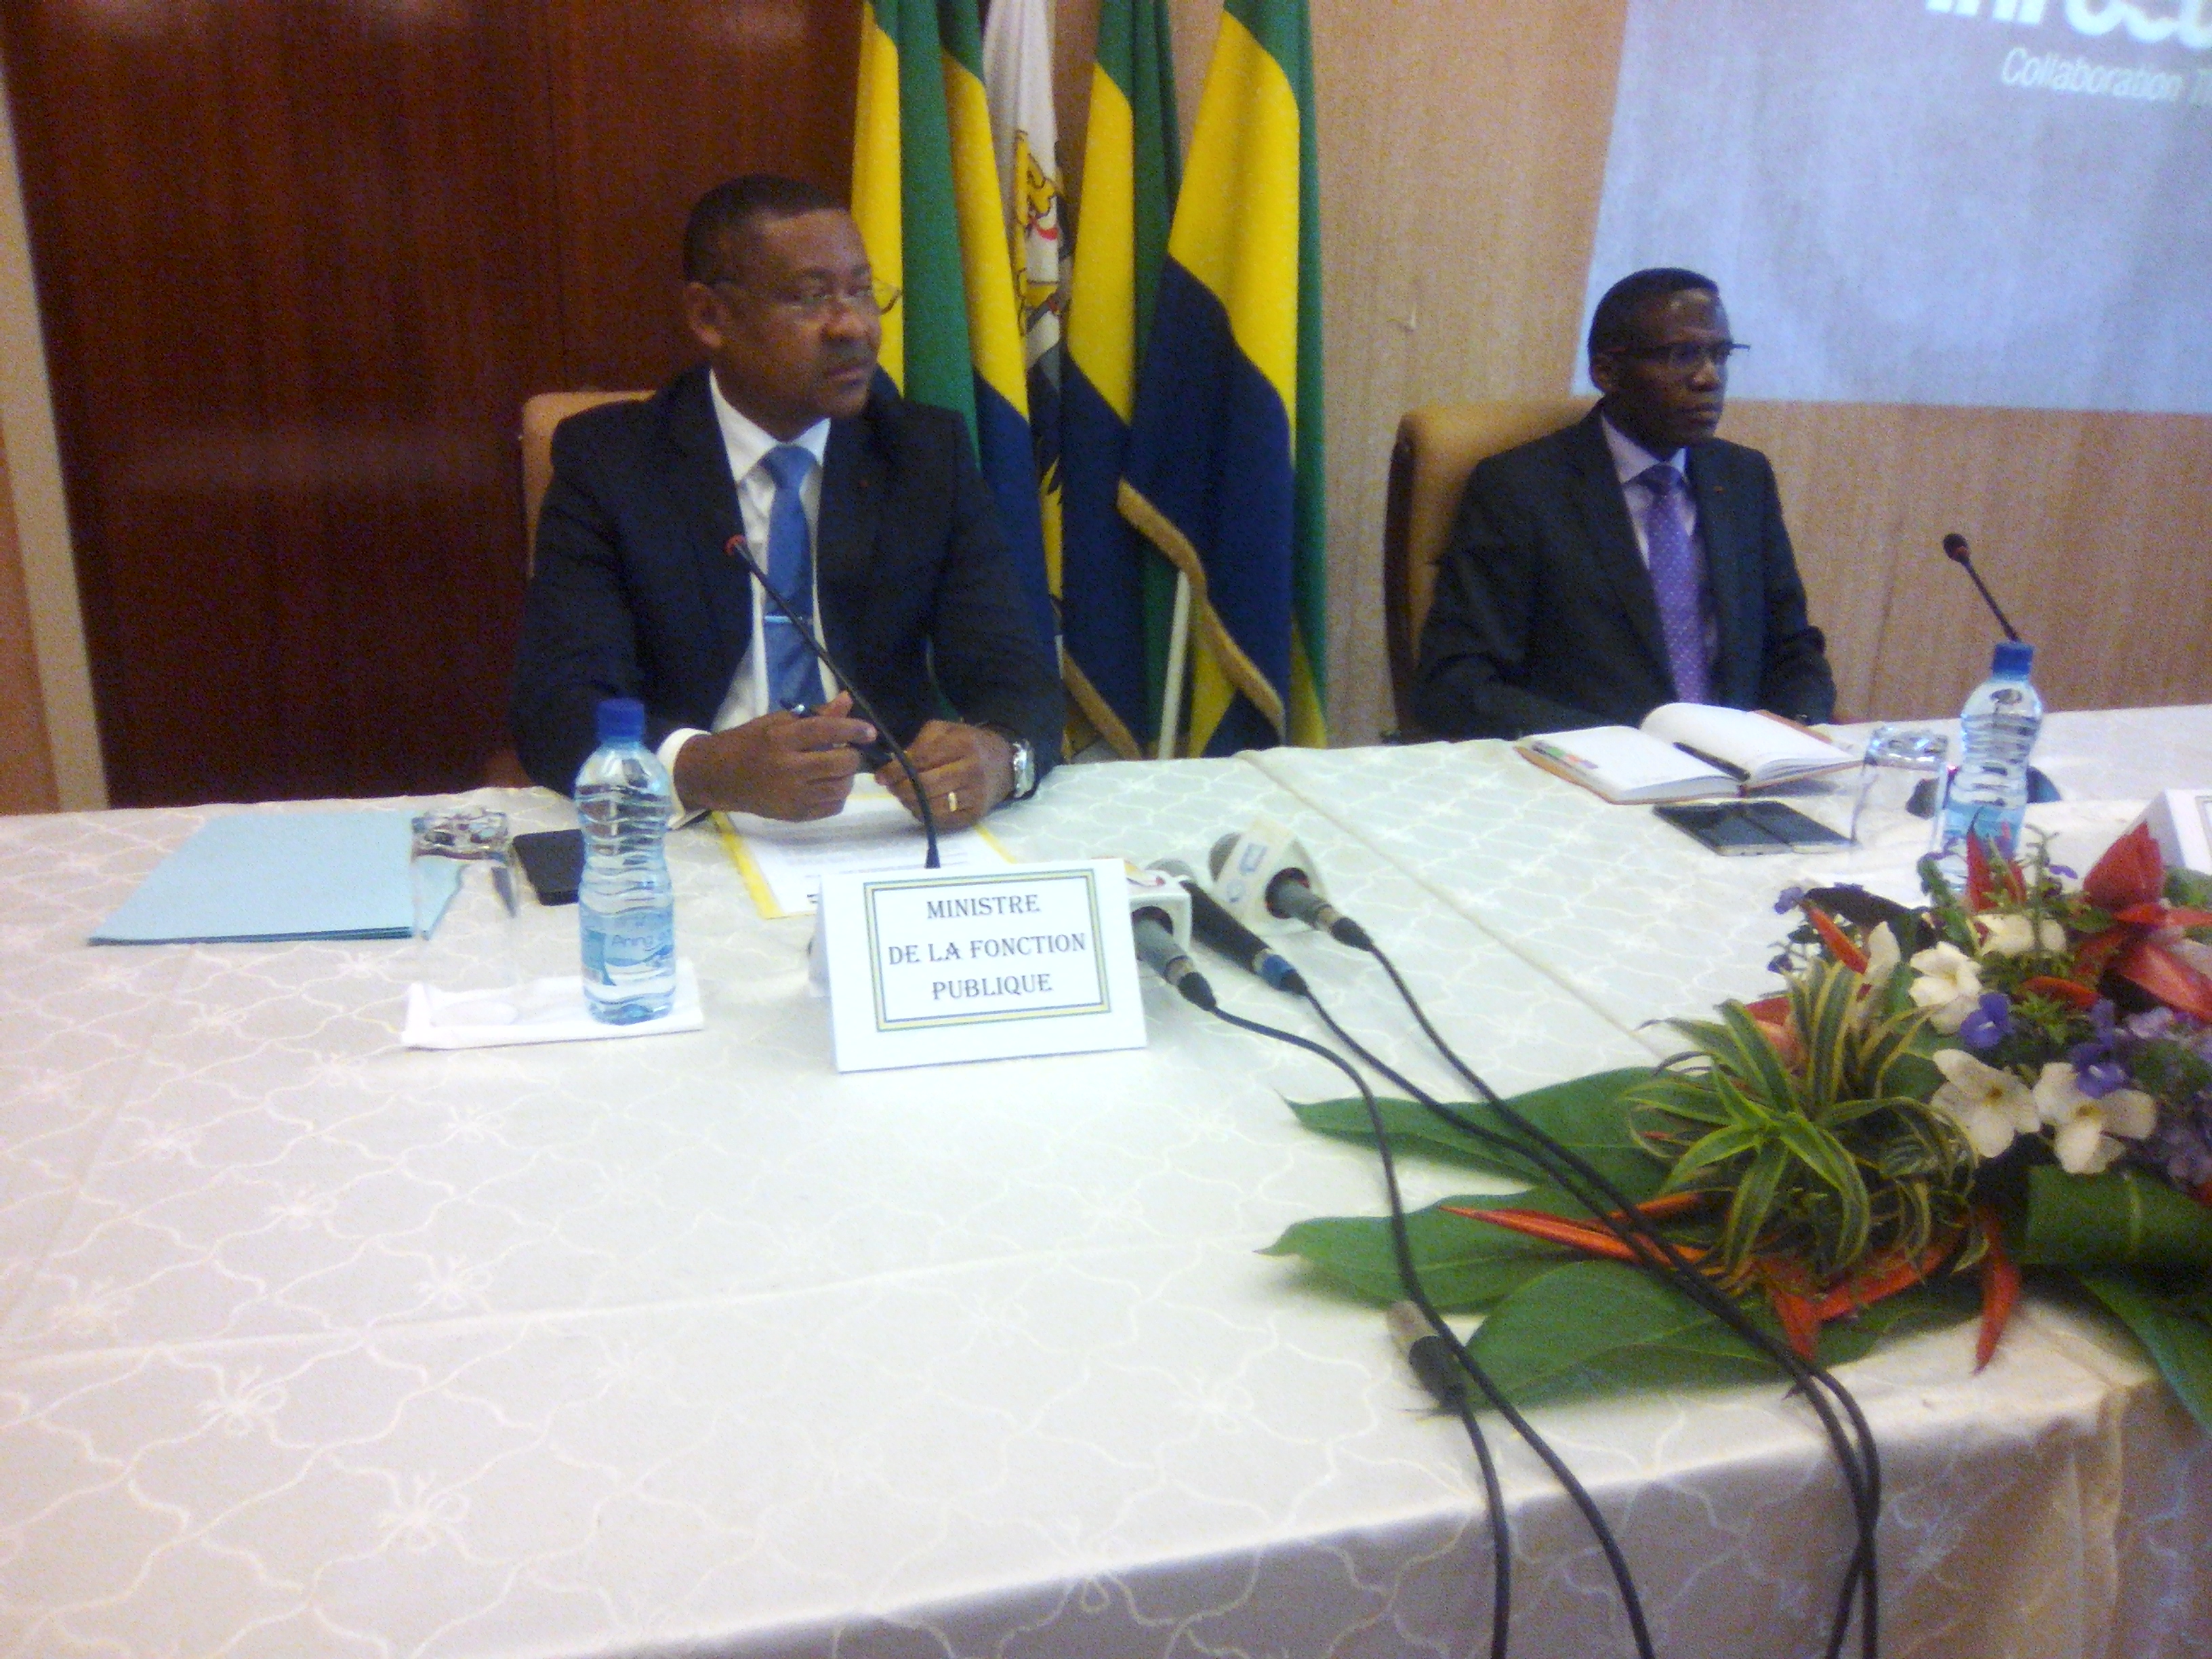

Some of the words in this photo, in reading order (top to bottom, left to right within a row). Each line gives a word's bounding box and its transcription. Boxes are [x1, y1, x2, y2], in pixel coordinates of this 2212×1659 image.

[2001, 47, 2183, 102] Collaboration
[926, 894, 1042, 919] MINISTRE
[888, 944, 920, 965] DE
[928, 941, 962, 962] LA
[970, 932, 1086, 959] FONCTION
[932, 972, 1054, 1000] PUBLIQUE
